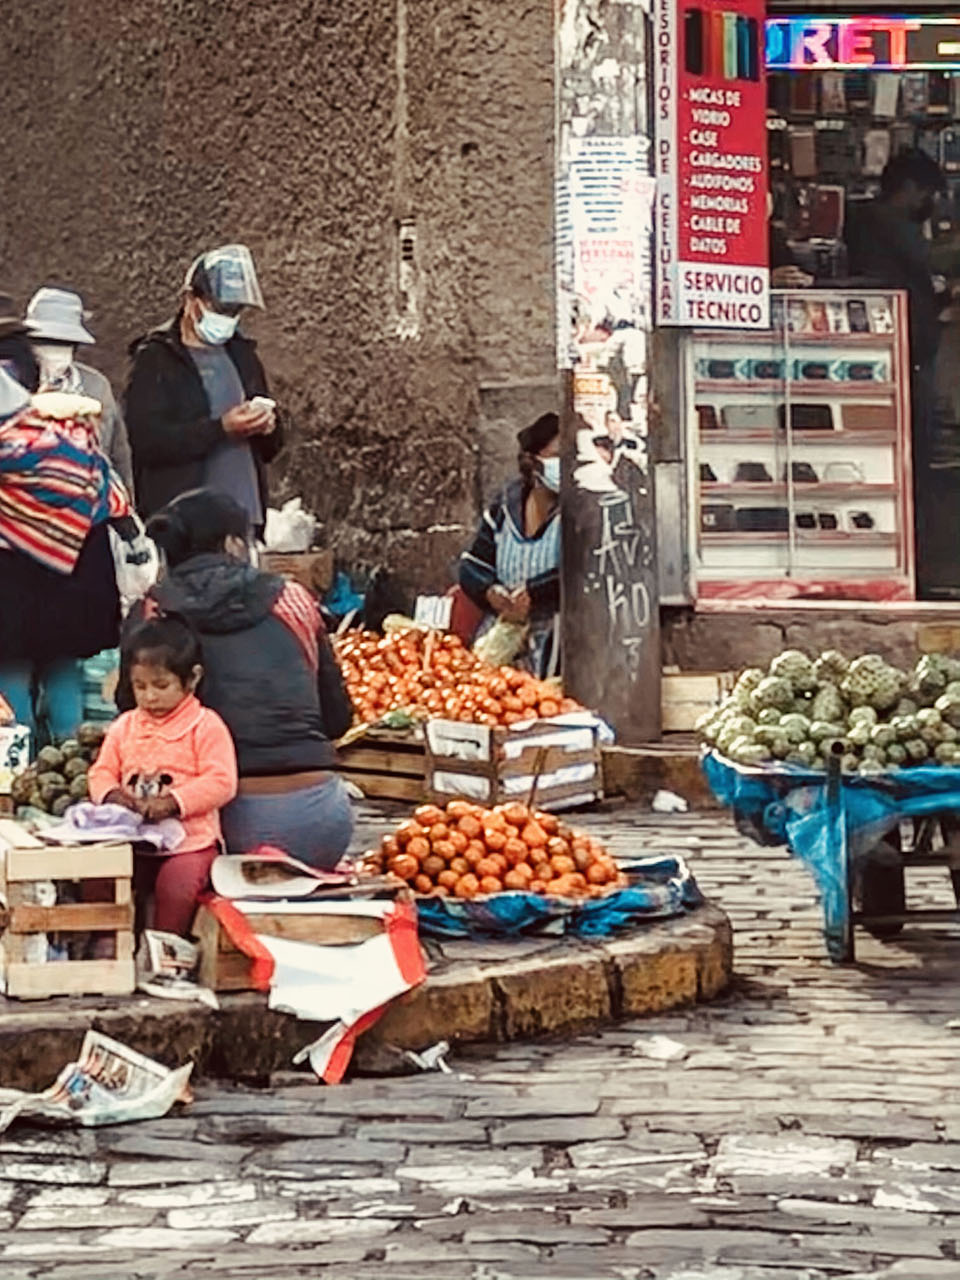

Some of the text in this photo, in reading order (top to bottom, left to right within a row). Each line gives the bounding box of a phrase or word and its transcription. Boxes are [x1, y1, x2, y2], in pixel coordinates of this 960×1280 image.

[689, 87, 741, 107] MICAS DE
[692, 108, 731, 127] VIDRIO
[690, 129, 718, 148] CASE
[659, 140, 672, 174] DE
[690, 151, 762, 173] CARGADORES
[690, 173, 755, 193] AUDIFONOS
[691, 195, 749, 214] MEMORIAS
[690, 215, 741, 234] CABLE DE
[690, 237, 727, 255] DATOS
[660, 194, 673, 320] CELULAR
[684, 271, 764, 296] SERVICIO
